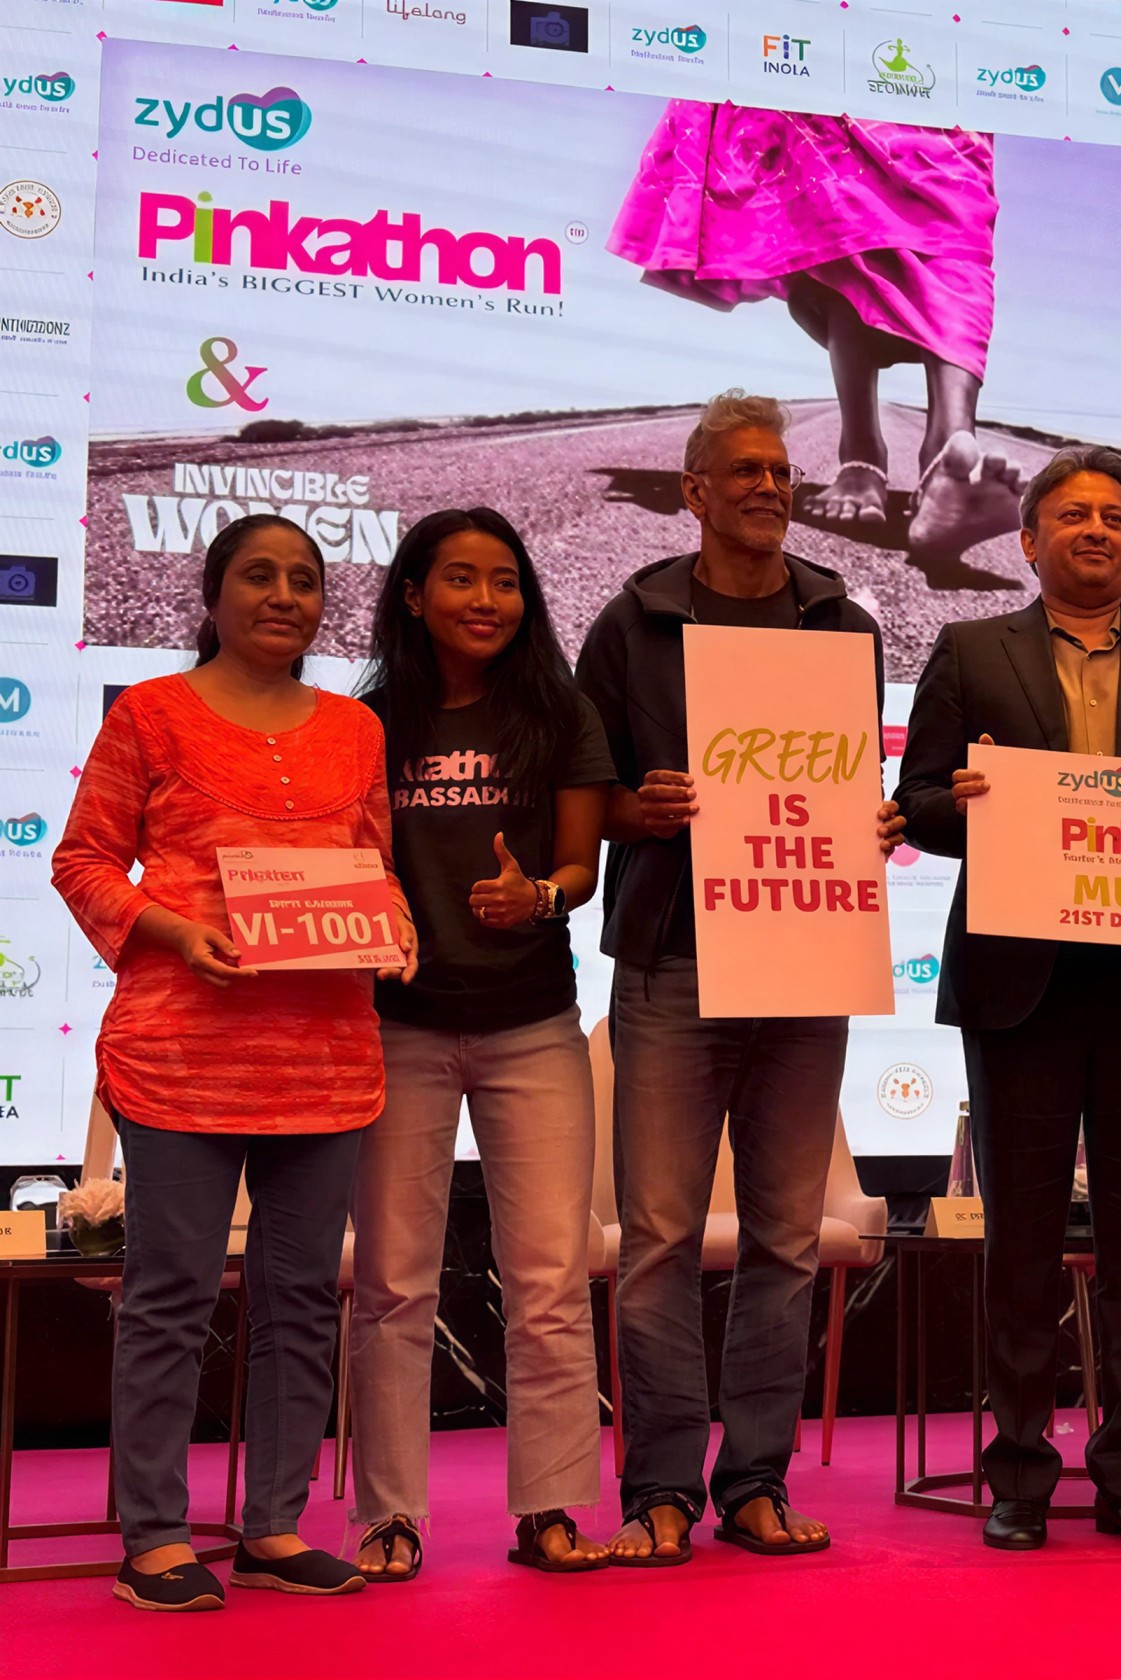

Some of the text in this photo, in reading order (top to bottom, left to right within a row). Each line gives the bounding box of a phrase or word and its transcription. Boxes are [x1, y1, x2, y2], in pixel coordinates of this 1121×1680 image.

[135, 96, 291, 140] zydus
[133, 146, 302, 175] Dedicated To Life
[138, 191, 561, 295] Pinkathon
[142, 266, 564, 317] India's BIGGEST Women's Run!
[187, 337, 269, 412] &
[174, 463, 370, 505] INVINCIBLE
[121, 493, 400, 566] WOEN
[702, 728, 867, 784] GREEN
[768, 793, 810, 827] IS
[744, 835, 834, 869] THE
[703, 878, 880, 912] FUTURE
[231, 911, 394, 946] VI-1001
[1059, 909, 1104, 926] 21ST
